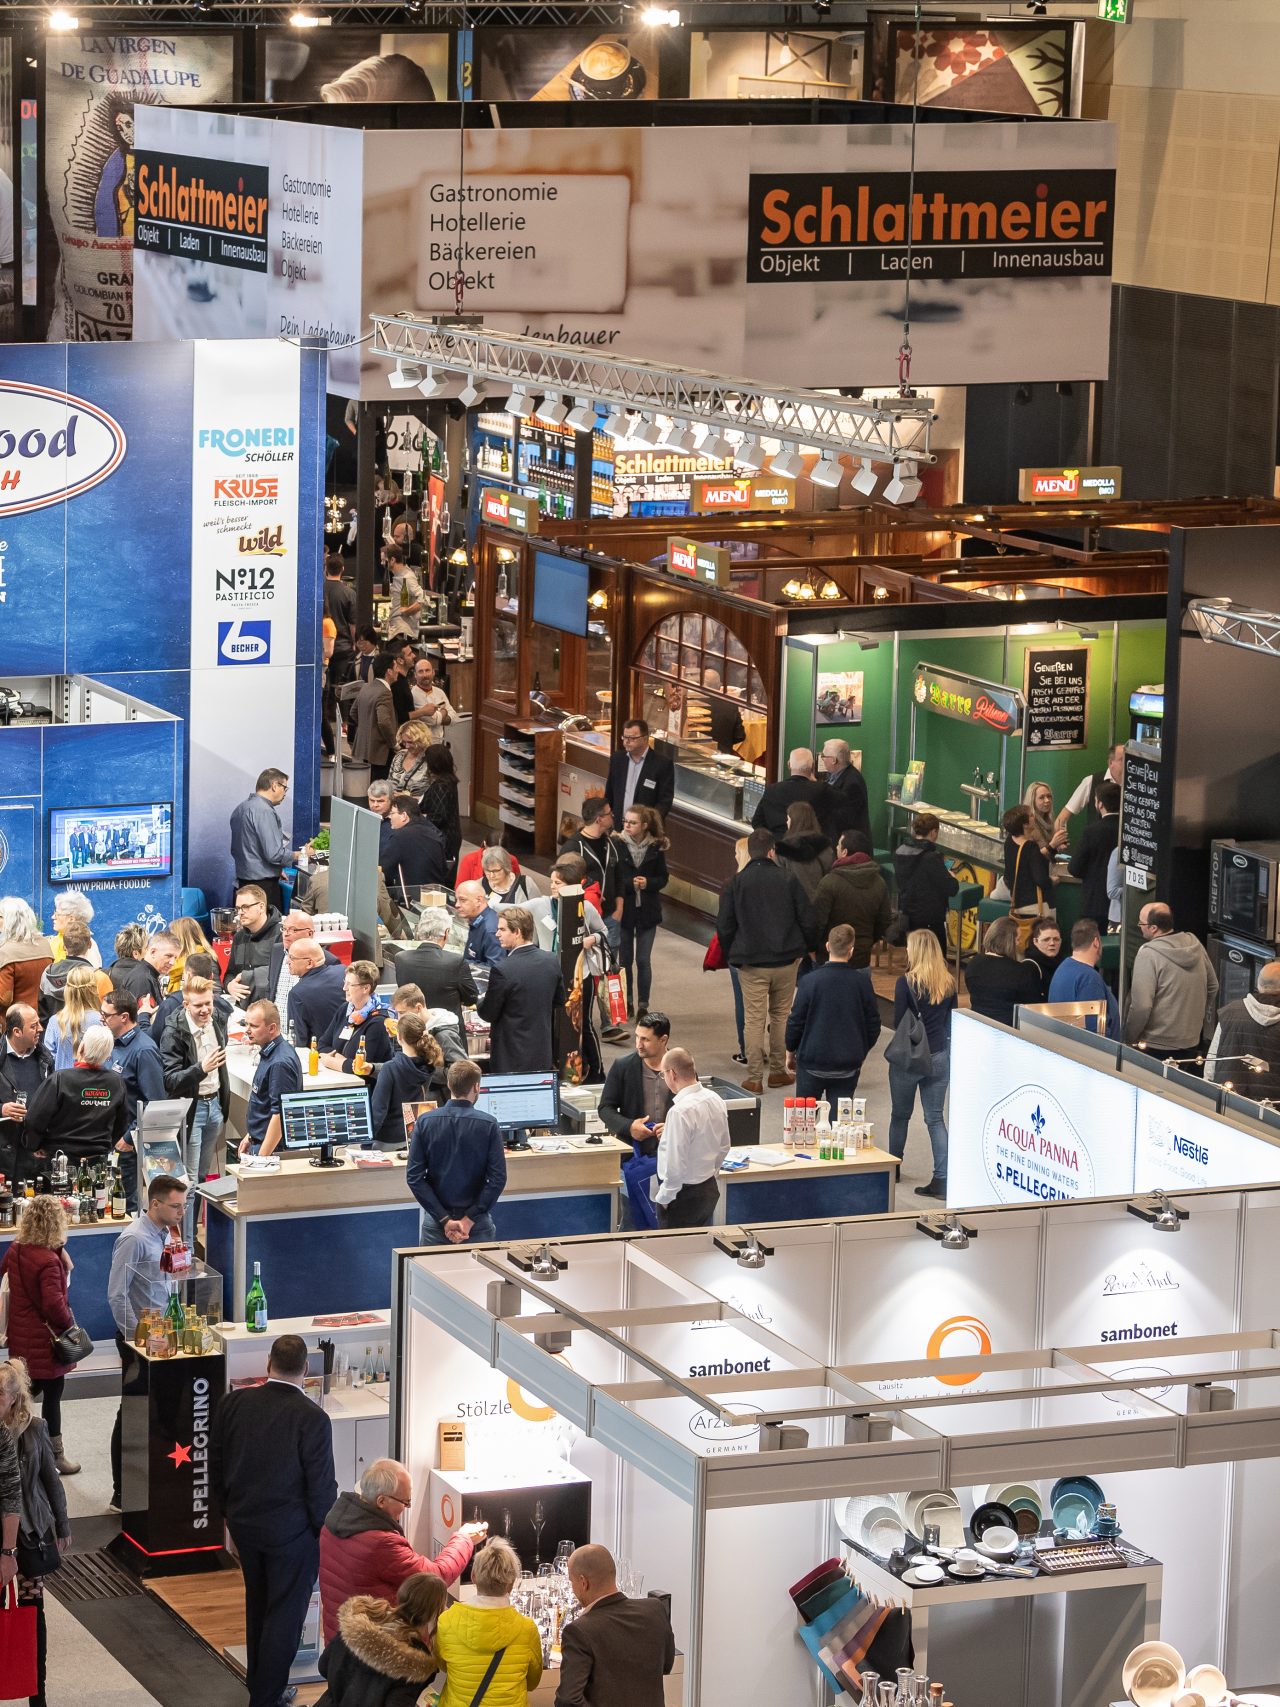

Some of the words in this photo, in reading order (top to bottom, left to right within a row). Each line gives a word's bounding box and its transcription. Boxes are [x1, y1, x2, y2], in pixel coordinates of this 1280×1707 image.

[106, 36, 176, 56] VIRGEN
[61, 62, 85, 80] DE
[89, 65, 201, 88] GUADALUPE
[282, 174, 332, 198] Gastronomie
[430, 182, 558, 203] Gastronomie
[138, 164, 267, 235] Schlattmeier
[282, 205, 319, 226] Hotellerie
[430, 212, 526, 232] Hotellerie
[760, 183, 1107, 244] Schlattmeier
[137, 224, 159, 245] Objekt
[180, 232, 200, 251] Laden
[221, 239, 266, 264] Innenausbau
[282, 230, 323, 254] Bäckereien
[430, 241, 536, 262] Bäckereien
[281, 259, 307, 284] Objekt
[760, 254, 821, 276] Objekt
[880, 253, 933, 271] Laden
[993, 249, 1104, 269] Innenausbau
[97, 272, 133, 286] GRA
[429, 271, 495, 290] Obekt
[73, 284, 123, 302] COLOMBIAN
[280, 315, 300, 336] Dein
[199, 427, 294, 457] FRONERI
[245, 450, 294, 462] SCHÖLLER
[614, 452, 734, 474] Schlattmeier
[214, 478, 278, 499] KRUSE
[217, 523, 252, 534] schmeckt
[227, 515, 248, 524] besser
[239, 525, 283, 552] wild
[216, 591, 274, 601] PASTIFICIO
[231, 643, 259, 653] BECHER
[1069, 677, 1082, 685] UNS
[1211, 851, 1219, 914] CHEFTOP
[998, 1118, 1036, 1152] ACQUA
[1039, 1137, 1078, 1172] PANNA
[996, 1144, 1008, 1158] THE
[1010, 1152, 1025, 1167] FINE
[1027, 1158, 1050, 1178] DINING
[1052, 1169, 1079, 1191] WATERS
[996, 1162, 1076, 1201] S.PELLEGRIN
[1101, 1321, 1177, 1342] sambonet
[689, 1356, 771, 1378] sambonet
[878, 1382, 903, 1391] Lausitz
[457, 1399, 512, 1418] Stölzle
[193, 1377, 210, 1529] S.PELLEGRINO
[706, 1445, 749, 1453] GERMANY
